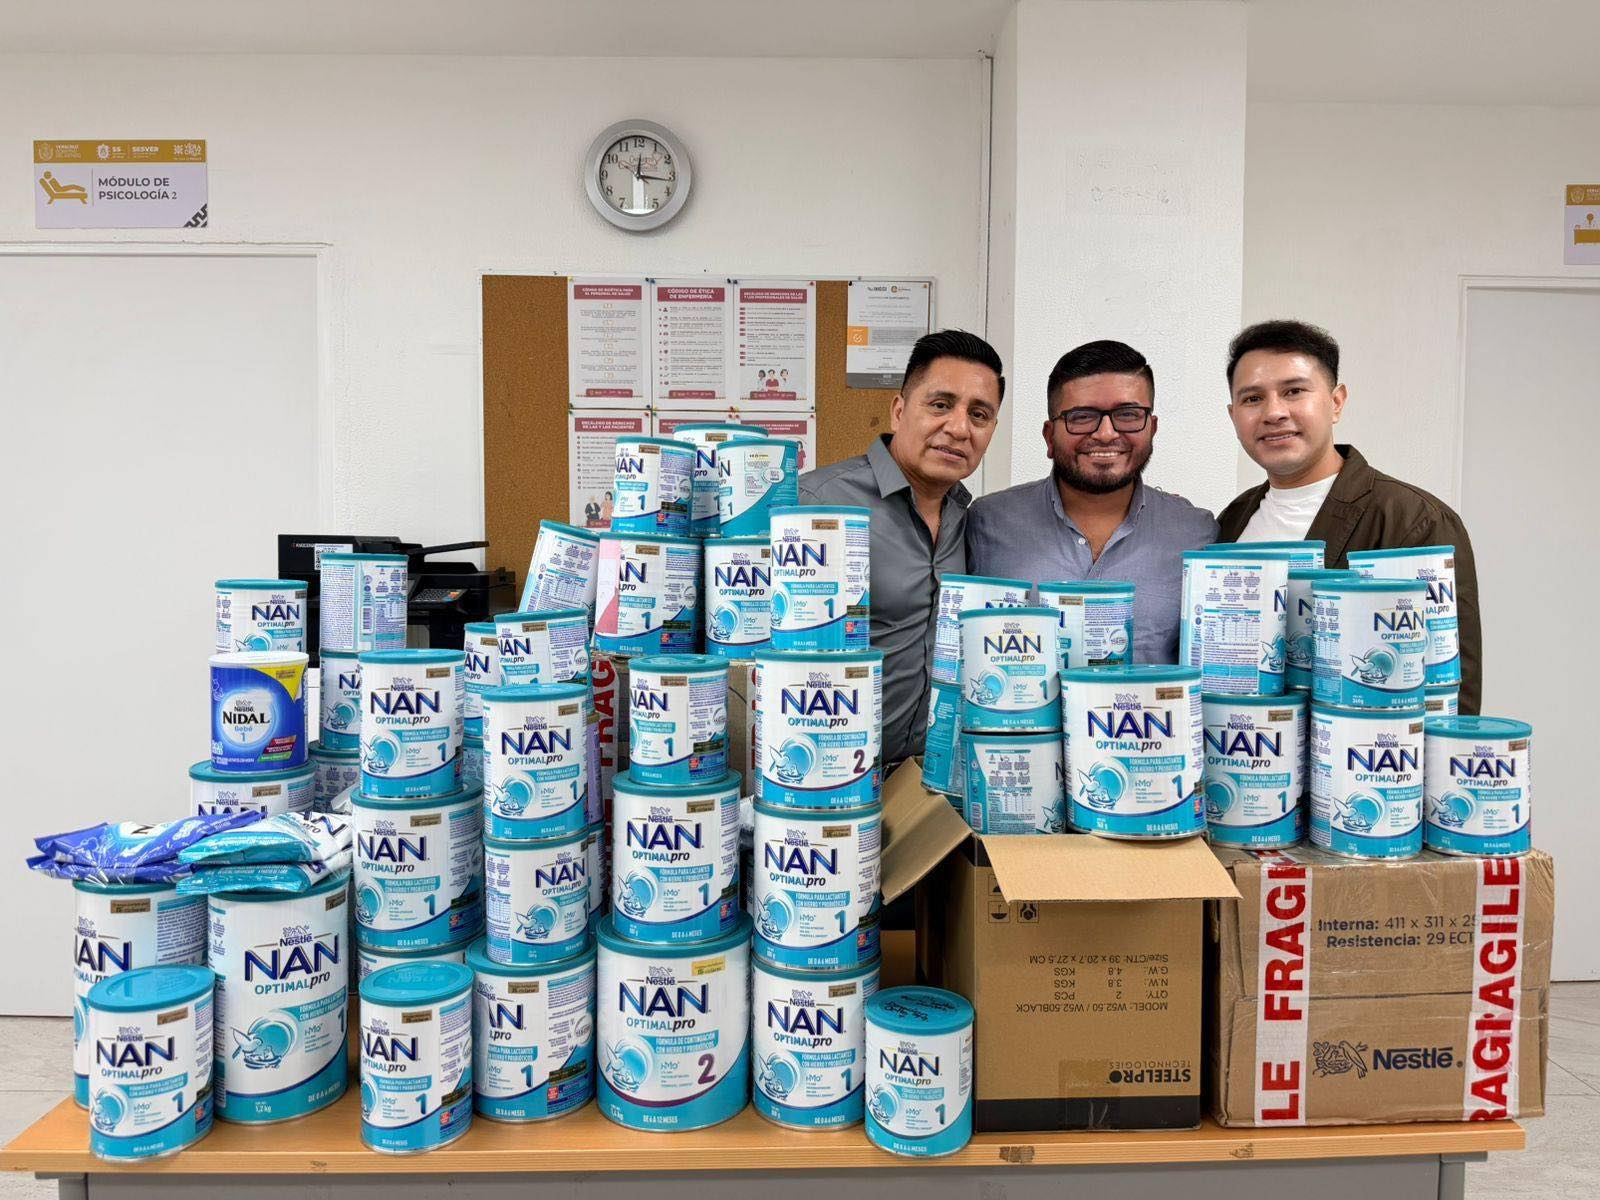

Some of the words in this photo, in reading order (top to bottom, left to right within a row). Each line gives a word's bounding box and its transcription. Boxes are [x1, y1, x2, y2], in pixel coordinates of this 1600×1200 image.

[620, 142, 629, 152] 11
[634, 138, 645, 148] 12
[653, 142, 658, 152] 1
[607, 154, 618, 164] 10
[664, 154, 671, 164] 2
[98, 176, 151, 186] MÓDULO
[154, 178, 170, 186] DE
[600, 170, 608, 180] 9
[668, 171, 676, 181] 3
[98, 188, 170, 200] PSICOLOGÍA
[171, 192, 178, 200] 2
[606, 185, 613, 196] 8
[664, 186, 672, 196] 4
[619, 197, 626, 208] 7
[652, 198, 659, 208] 5
[637, 494, 646, 510] 1
[772, 543, 826, 567] NAN
[714, 566, 771, 587] NAN
[251, 604, 300, 621] NAN
[824, 598, 834, 619] 1
[641, 611, 652, 630] 1
[1374, 610, 1424, 631] NAN
[984, 634, 1041, 654] NAN
[1060, 652, 1069, 669] 1
[806, 680, 832, 689] Nestlé
[1040, 680, 1048, 700] 1
[370, 691, 440, 715] NAN
[781, 688, 858, 716] NAN
[1113, 702, 1142, 710] Nestlé
[222, 711, 270, 725] NIDAL
[788, 716, 848, 729] OPTIMALpro
[1087, 710, 1172, 739] NAN
[501, 728, 571, 756] NAN
[664, 737, 674, 757] 1
[1096, 740, 1162, 753] OPTIMALpro
[1203, 728, 1281, 757] NAN
[437, 742, 447, 762] 1
[508, 754, 563, 765] OPTIMALpro
[1347, 747, 1418, 772] NAN
[853, 749, 866, 774] 2
[1450, 756, 1516, 778] NAN
[570, 780, 577, 800] 1
[1171, 774, 1182, 799] 1
[1277, 790, 1287, 813] 1
[1511, 803, 1520, 824] 1
[627, 820, 702, 850] NAN
[784, 837, 810, 847] Nestlé
[358, 832, 427, 862] NAN
[632, 850, 690, 863] OPTIMALpro
[764, 842, 838, 875] NAN
[362, 861, 415, 875] OPTIMALpro
[535, 858, 585, 888] NAN
[769, 872, 826, 888] OPTIMALpro
[698, 882, 709, 906] 1
[424, 893, 436, 916] 1
[834, 910, 846, 934] 1
[1318, 919, 1380, 932] Interna:
[1384, 918, 1405, 930] 411
[1411, 920, 1418, 928] x
[1424, 916, 1444, 928] 311
[1449, 918, 1456, 927] x
[280, 934, 313, 947] Nestlé
[1326, 935, 1420, 949] Resistencia:
[1426, 933, 1444, 946] 29
[1448, 932, 1474, 944] ECT
[244, 933, 340, 982] NAN
[1029, 955, 1046, 964] CM
[1049, 955, 1068, 963] 27.5
[1079, 955, 1099, 963] 20.7
[1109, 955, 1120, 963] 39
[1122, 954, 1168, 963] Size/CTN:
[1054, 967, 1075, 976] KGS
[1108, 967, 1122, 976] 4.8
[254, 970, 331, 995] OPTIMALpro
[646, 976, 676, 985] Nestlé
[1054, 979, 1075, 988] KGS
[1108, 979, 1122, 987] 3.8
[619, 981, 709, 1018] NAN
[1054, 991, 1075, 1000] PCS
[1116, 991, 1122, 1000] 2
[1145, 990, 1168, 999] QTY:
[789, 998, 815, 1008] Nestlé
[1016, 1002, 1084, 1012] W52.50BLACK
[1092, 1002, 1127, 1011] W52.50
[1130, 1002, 1168, 1011] MODEL:
[626, 1017, 696, 1032] OPTIMALpro
[768, 1000, 844, 1036] NAN
[774, 1032, 832, 1048] OPTIMALpro
[96, 1037, 176, 1068] NAN
[1372, 1047, 1453, 1070] Nestlé
[698, 1053, 715, 1085] 2
[880, 1048, 940, 1076] NAN
[1108, 1060, 1191, 1068] TECHNOLOGIES
[101, 1064, 163, 1080] OPTIMALpro
[520, 1064, 534, 1088] 1
[840, 1068, 852, 1092] 1
[1108, 1068, 1192, 1084] STEELPRO
[172, 1091, 184, 1113] 1
[415, 1093, 427, 1115] 1
[934, 1103, 946, 1125] 1
